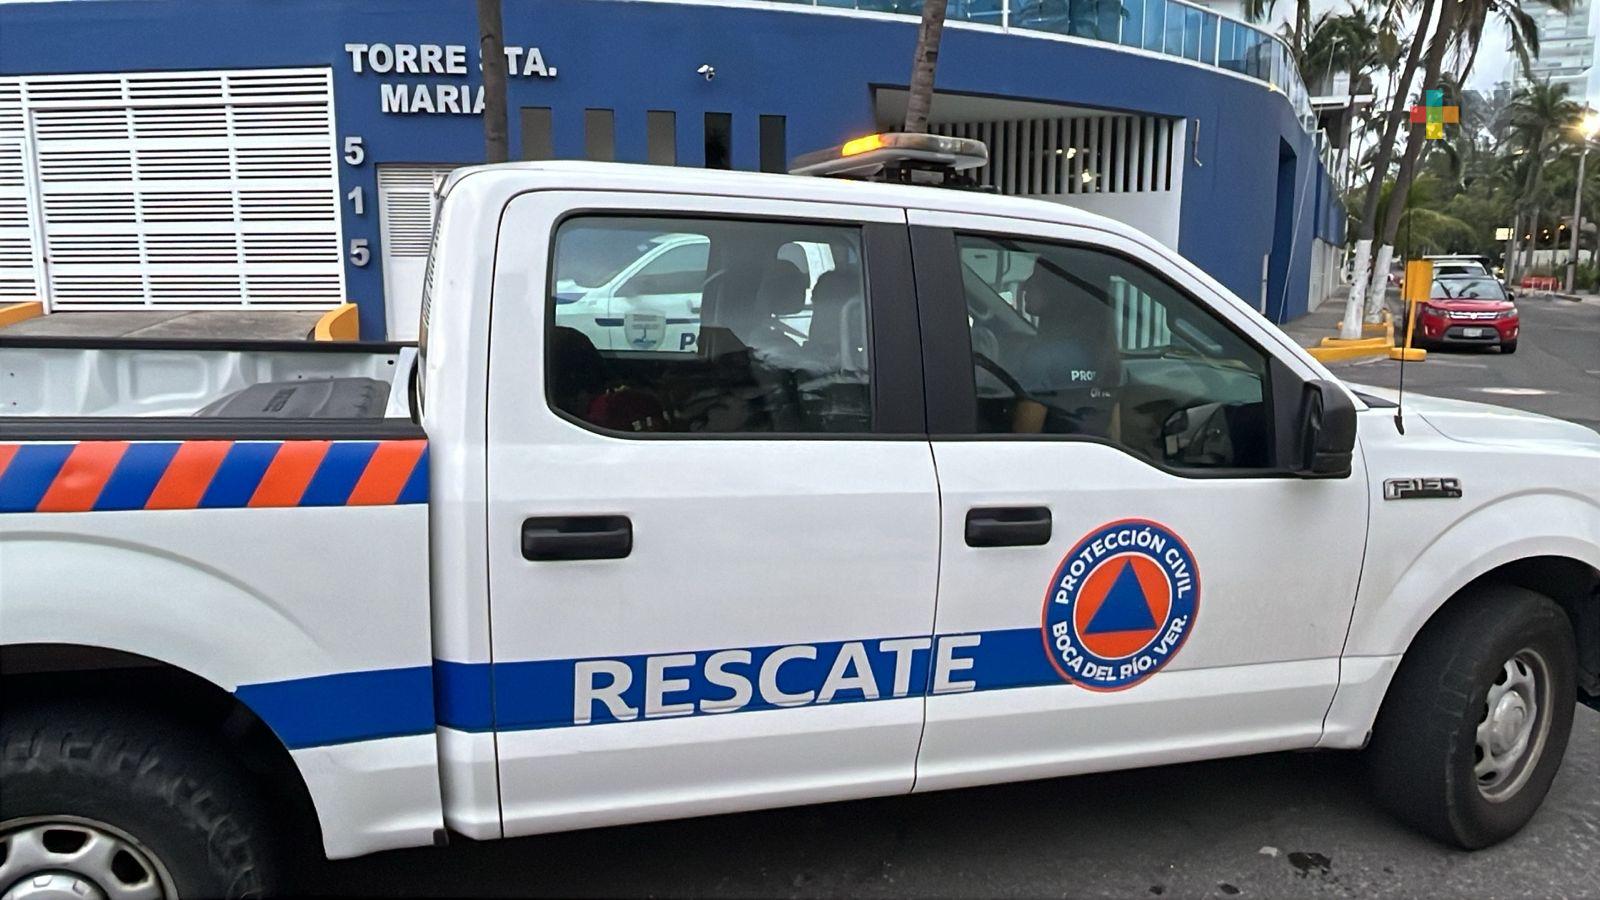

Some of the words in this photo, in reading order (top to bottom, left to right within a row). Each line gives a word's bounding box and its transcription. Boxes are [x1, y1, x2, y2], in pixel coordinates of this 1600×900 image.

[344, 43, 467, 74] TORRE
[479, 46, 557, 77] TA.
[1055, 527, 1167, 605] PROTECCIÓN
[1165, 549, 1192, 599] CIVIL
[573, 634, 981, 725] RESCATE
[1052, 621, 1084, 672] BOCA
[1081, 662, 1117, 681] DEL
[1153, 614, 1188, 655] VER.
